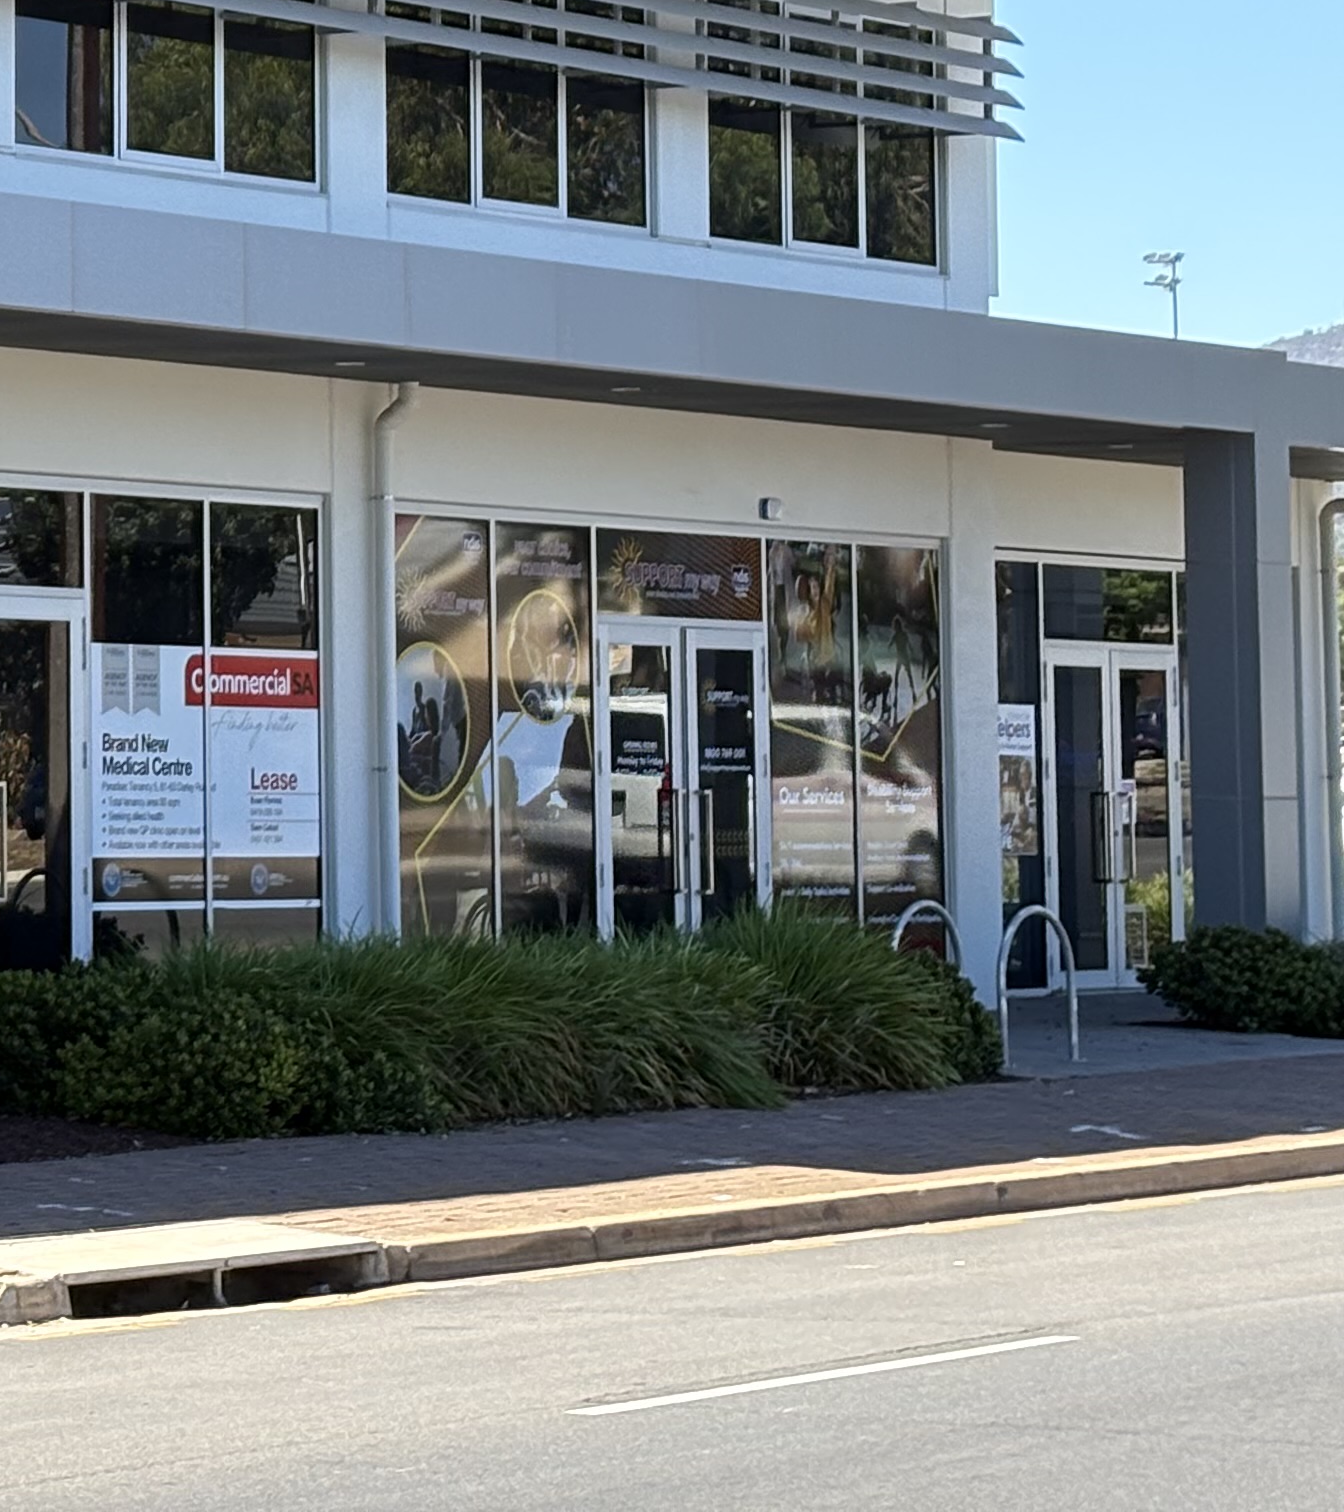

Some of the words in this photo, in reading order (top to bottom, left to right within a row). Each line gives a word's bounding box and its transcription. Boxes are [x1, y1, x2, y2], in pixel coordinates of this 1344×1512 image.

[624, 561, 685, 589] SUPPORT
[102, 733, 139, 753] Brand
[141, 733, 170, 754] New
[102, 756, 150, 776] Medical
[152, 756, 193, 777] Centre
[251, 767, 298, 791] Lease
[778, 786, 800, 805] Our
[802, 786, 845, 806] Services
